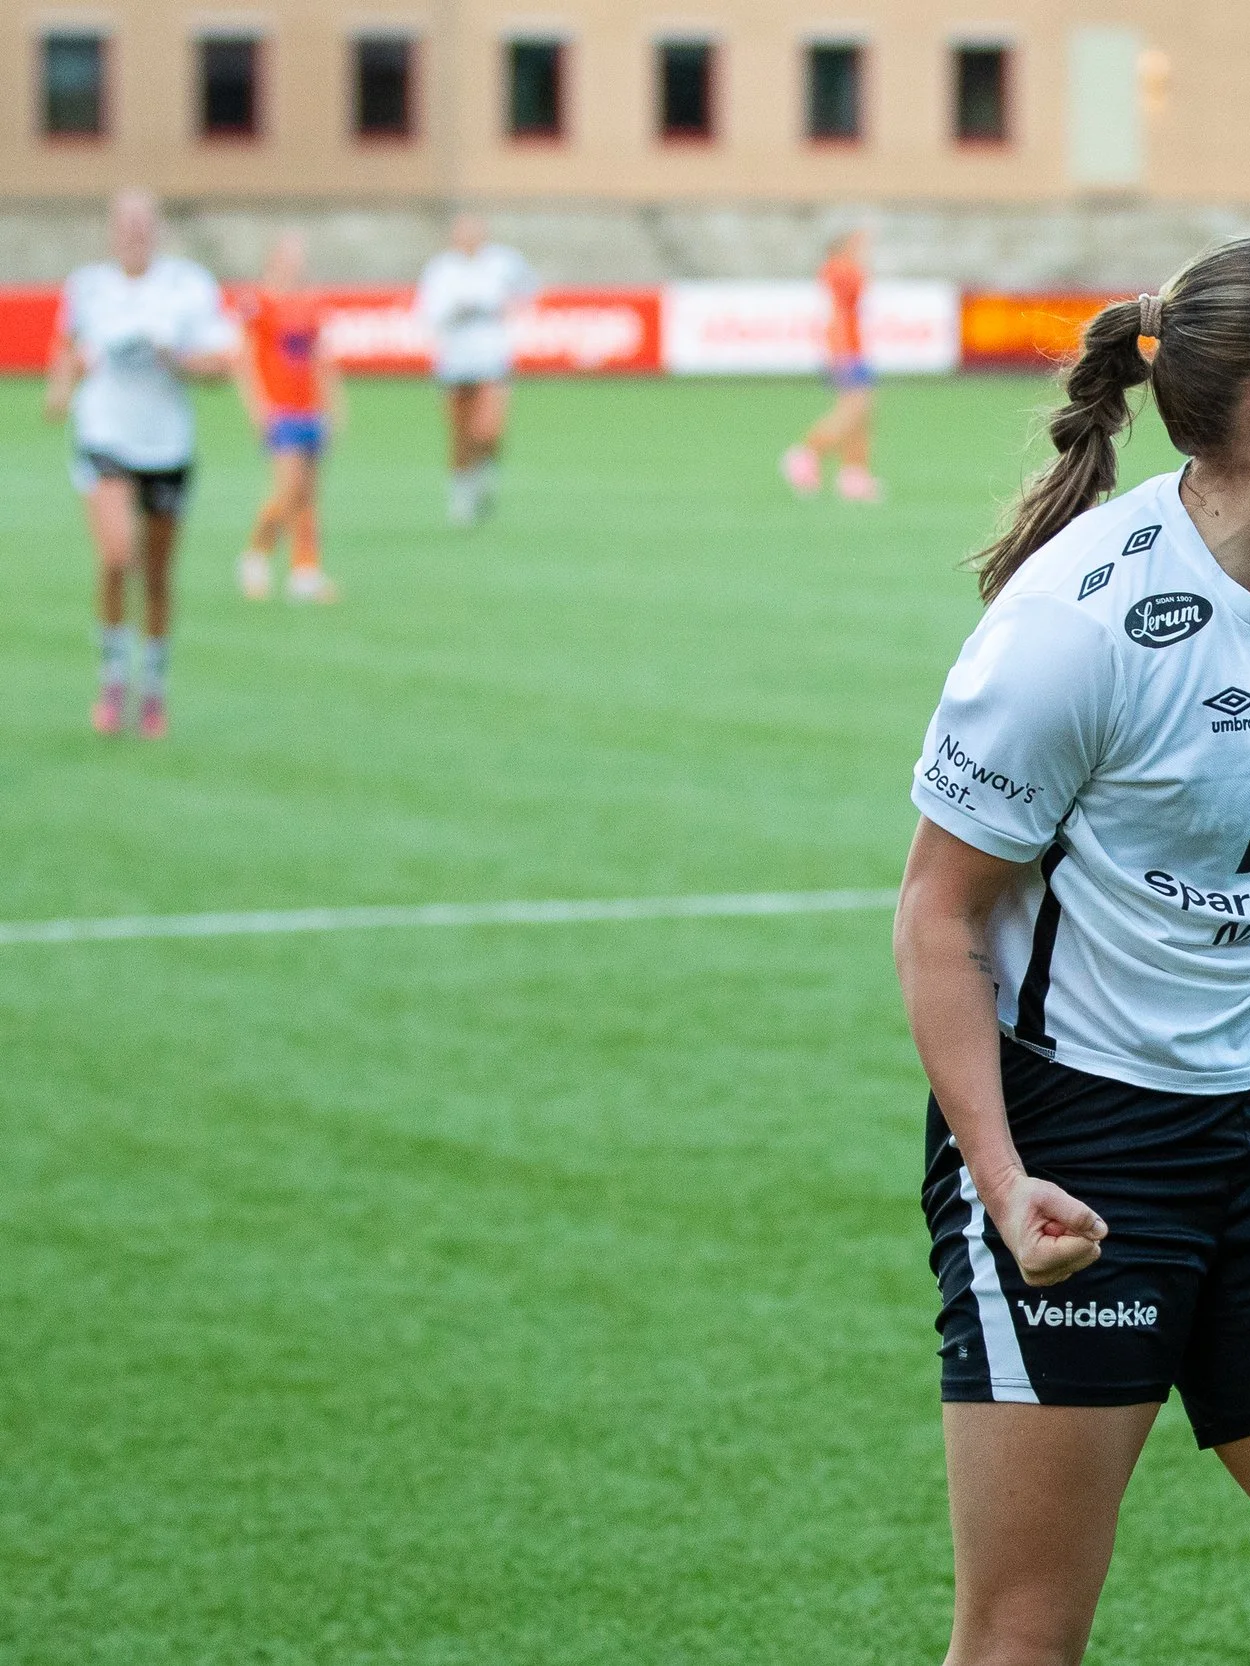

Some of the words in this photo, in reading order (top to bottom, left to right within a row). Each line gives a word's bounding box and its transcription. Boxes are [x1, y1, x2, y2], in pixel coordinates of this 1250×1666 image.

[1155, 596, 1175, 605] SIDAN
[1176, 595, 1193, 603] 1907
[1131, 601, 1202, 642] Lerum
[938, 734, 1037, 804] Norway's
[1018, 1300, 1158, 1327] Veidekke
